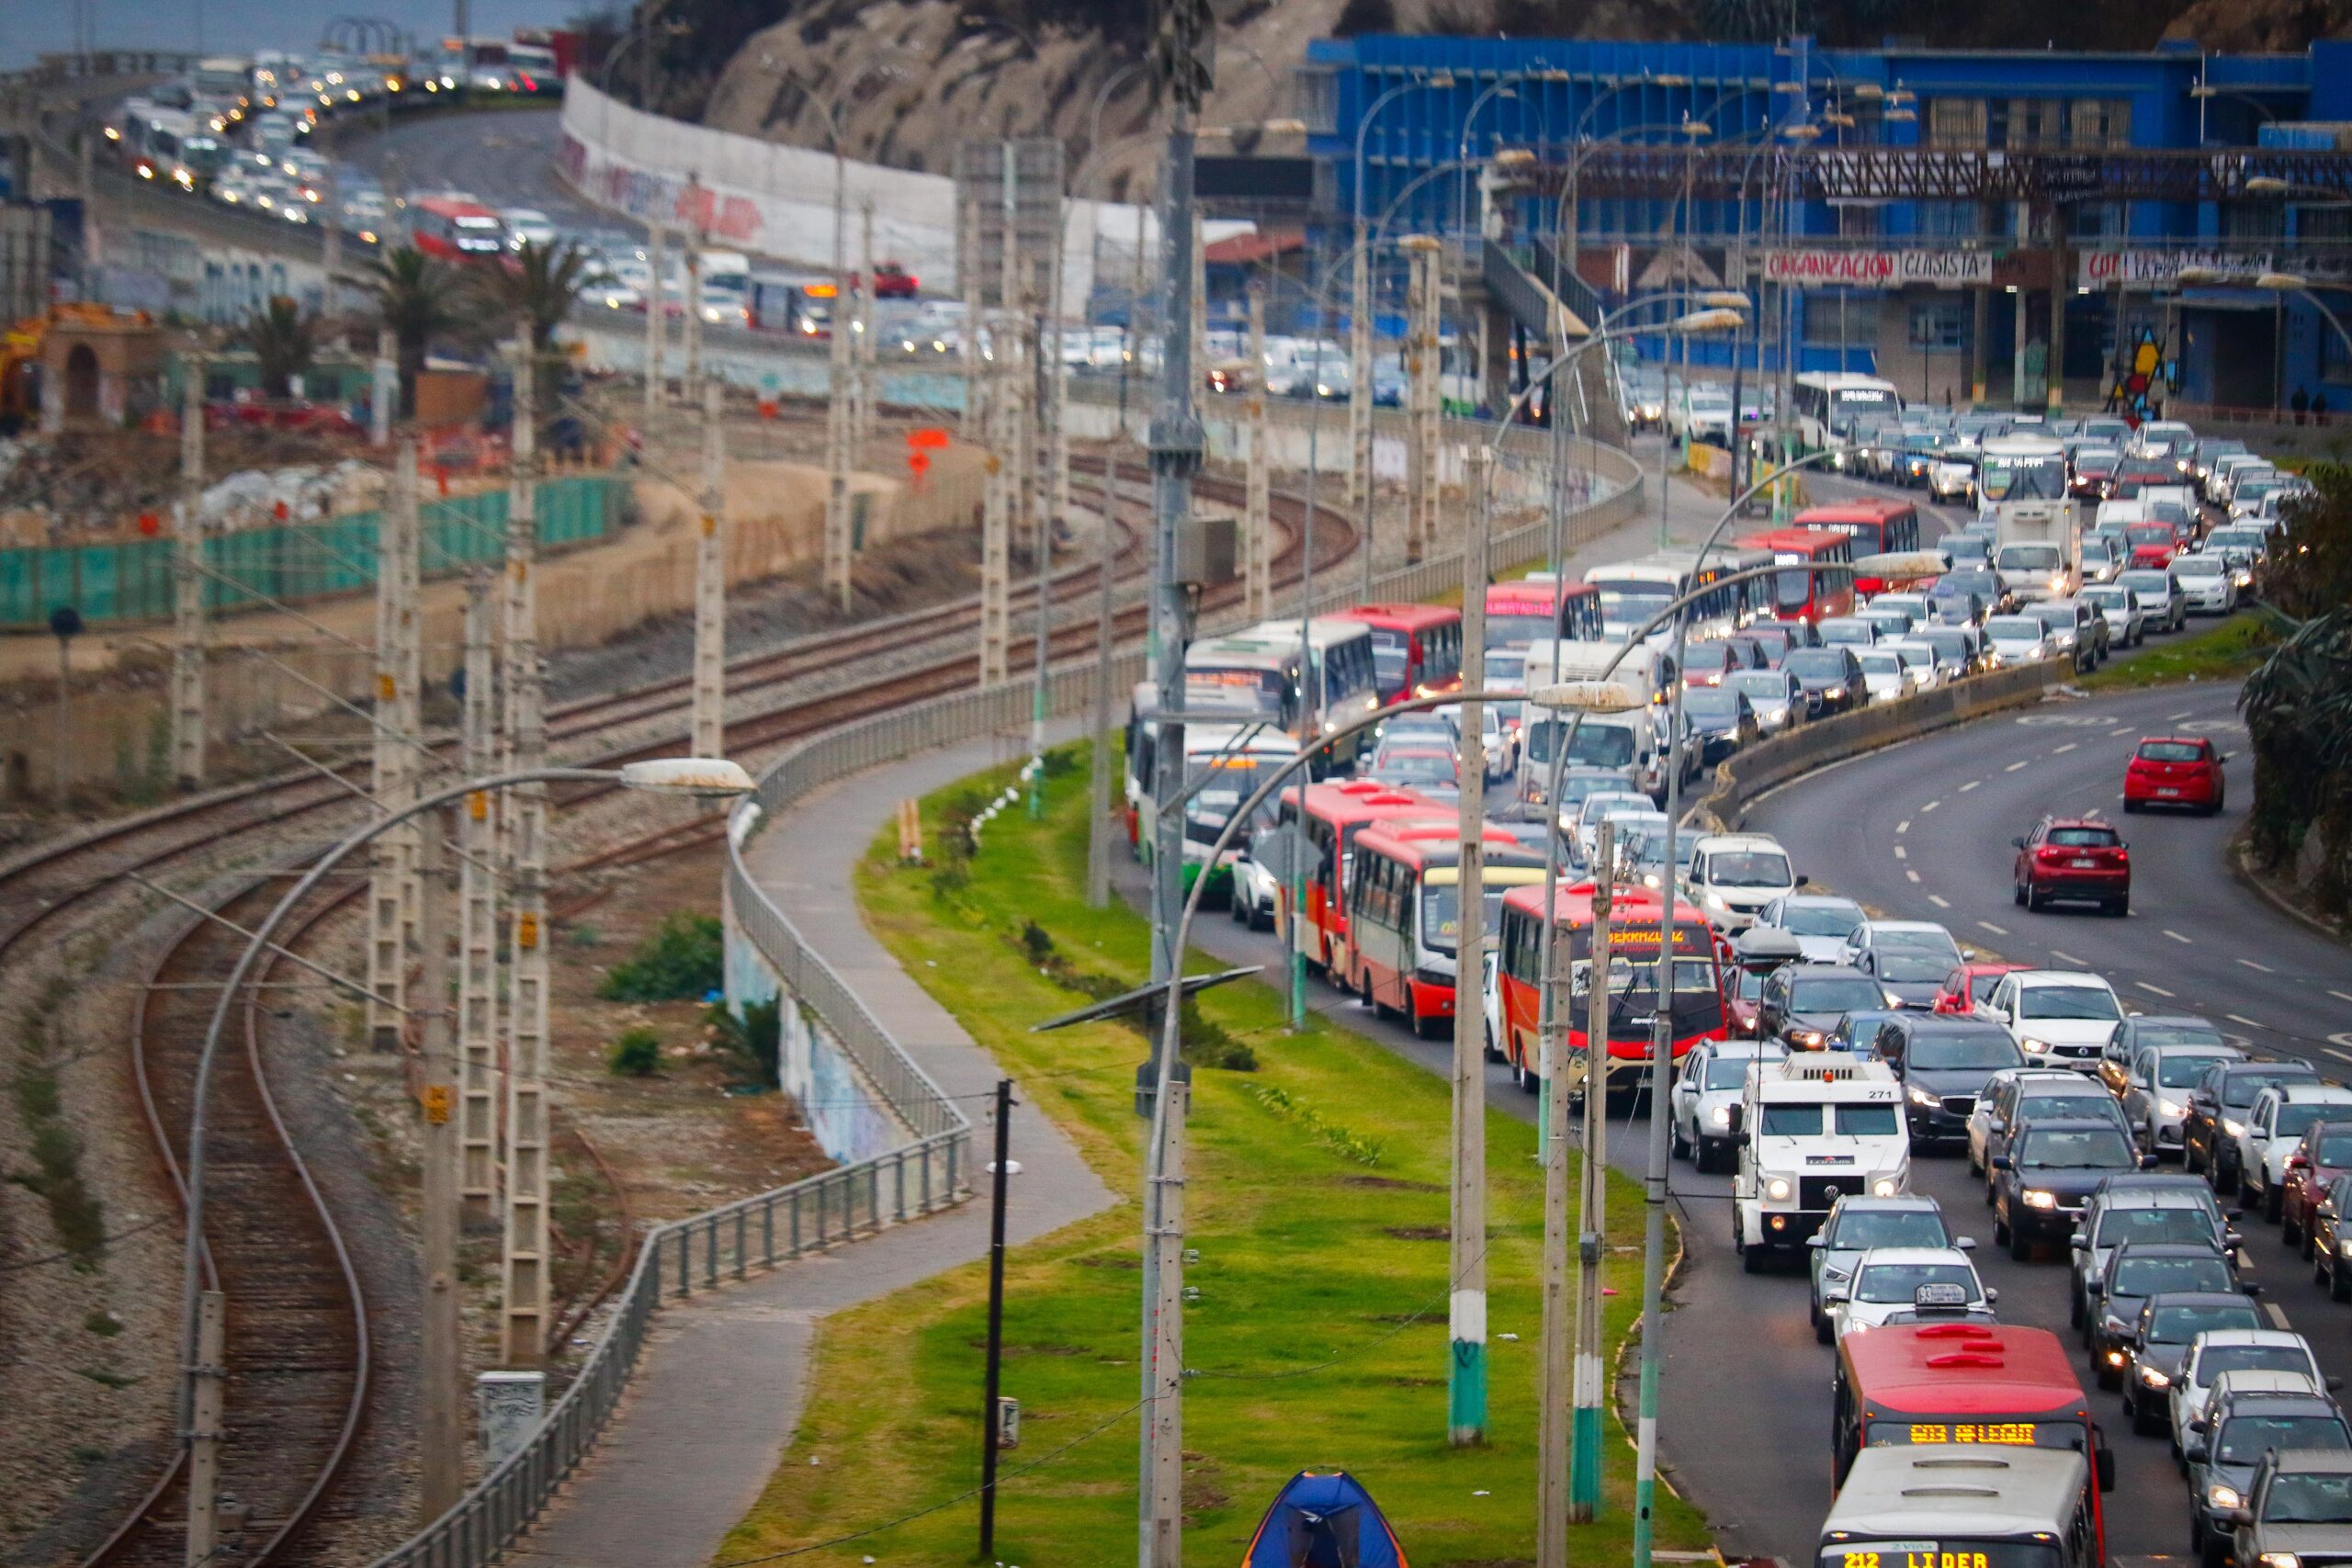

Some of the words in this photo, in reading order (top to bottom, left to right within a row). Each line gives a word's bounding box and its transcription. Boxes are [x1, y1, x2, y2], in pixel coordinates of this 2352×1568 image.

[1869, 1090, 1893, 1100] 271
[1843, 1552, 1880, 1568] 212
[1906, 1552, 1990, 1568] LIDER
